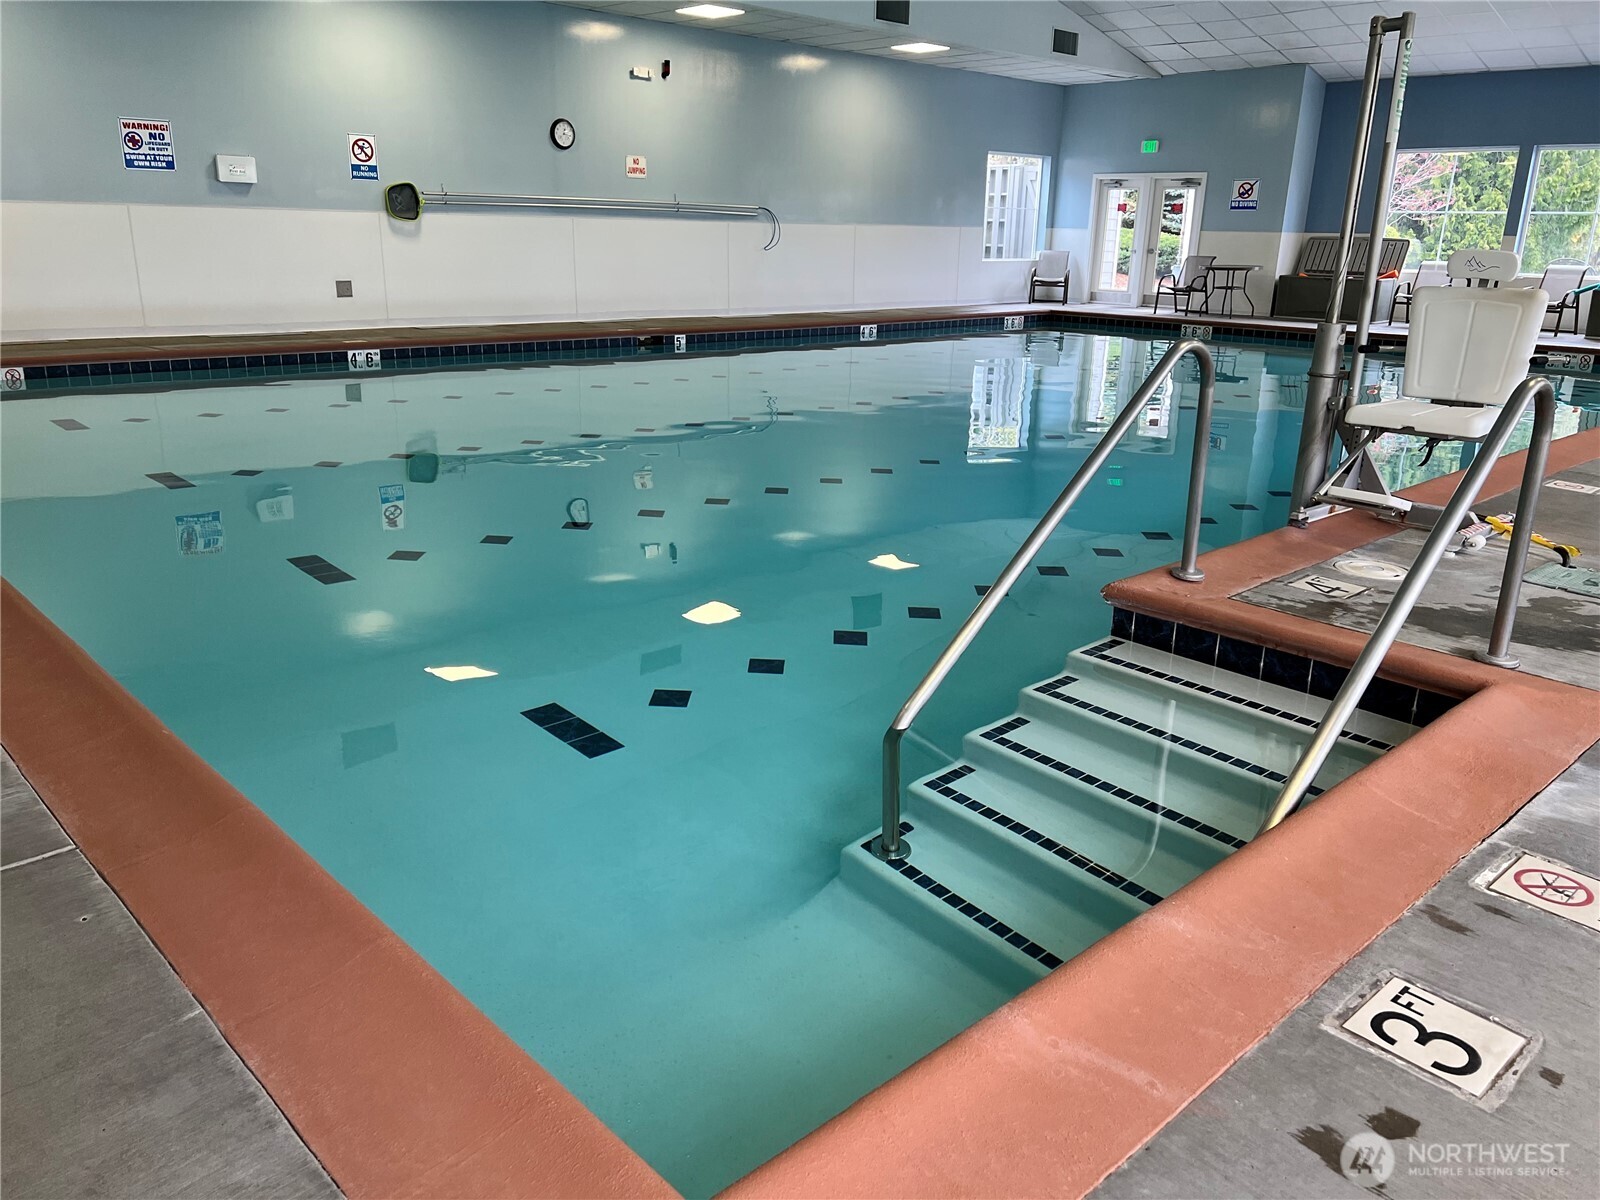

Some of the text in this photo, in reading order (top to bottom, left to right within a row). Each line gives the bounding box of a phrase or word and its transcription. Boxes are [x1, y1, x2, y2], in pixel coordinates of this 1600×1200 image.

[122, 122, 168, 131] WARNING!
[148, 132, 165, 141] NO
[350, 352, 357, 364] 4
[366, 352, 373, 364] 6
[1305, 581, 1349, 593] 4
[1390, 985, 1435, 1017] FT
[1370, 1010, 1482, 1076] 3
